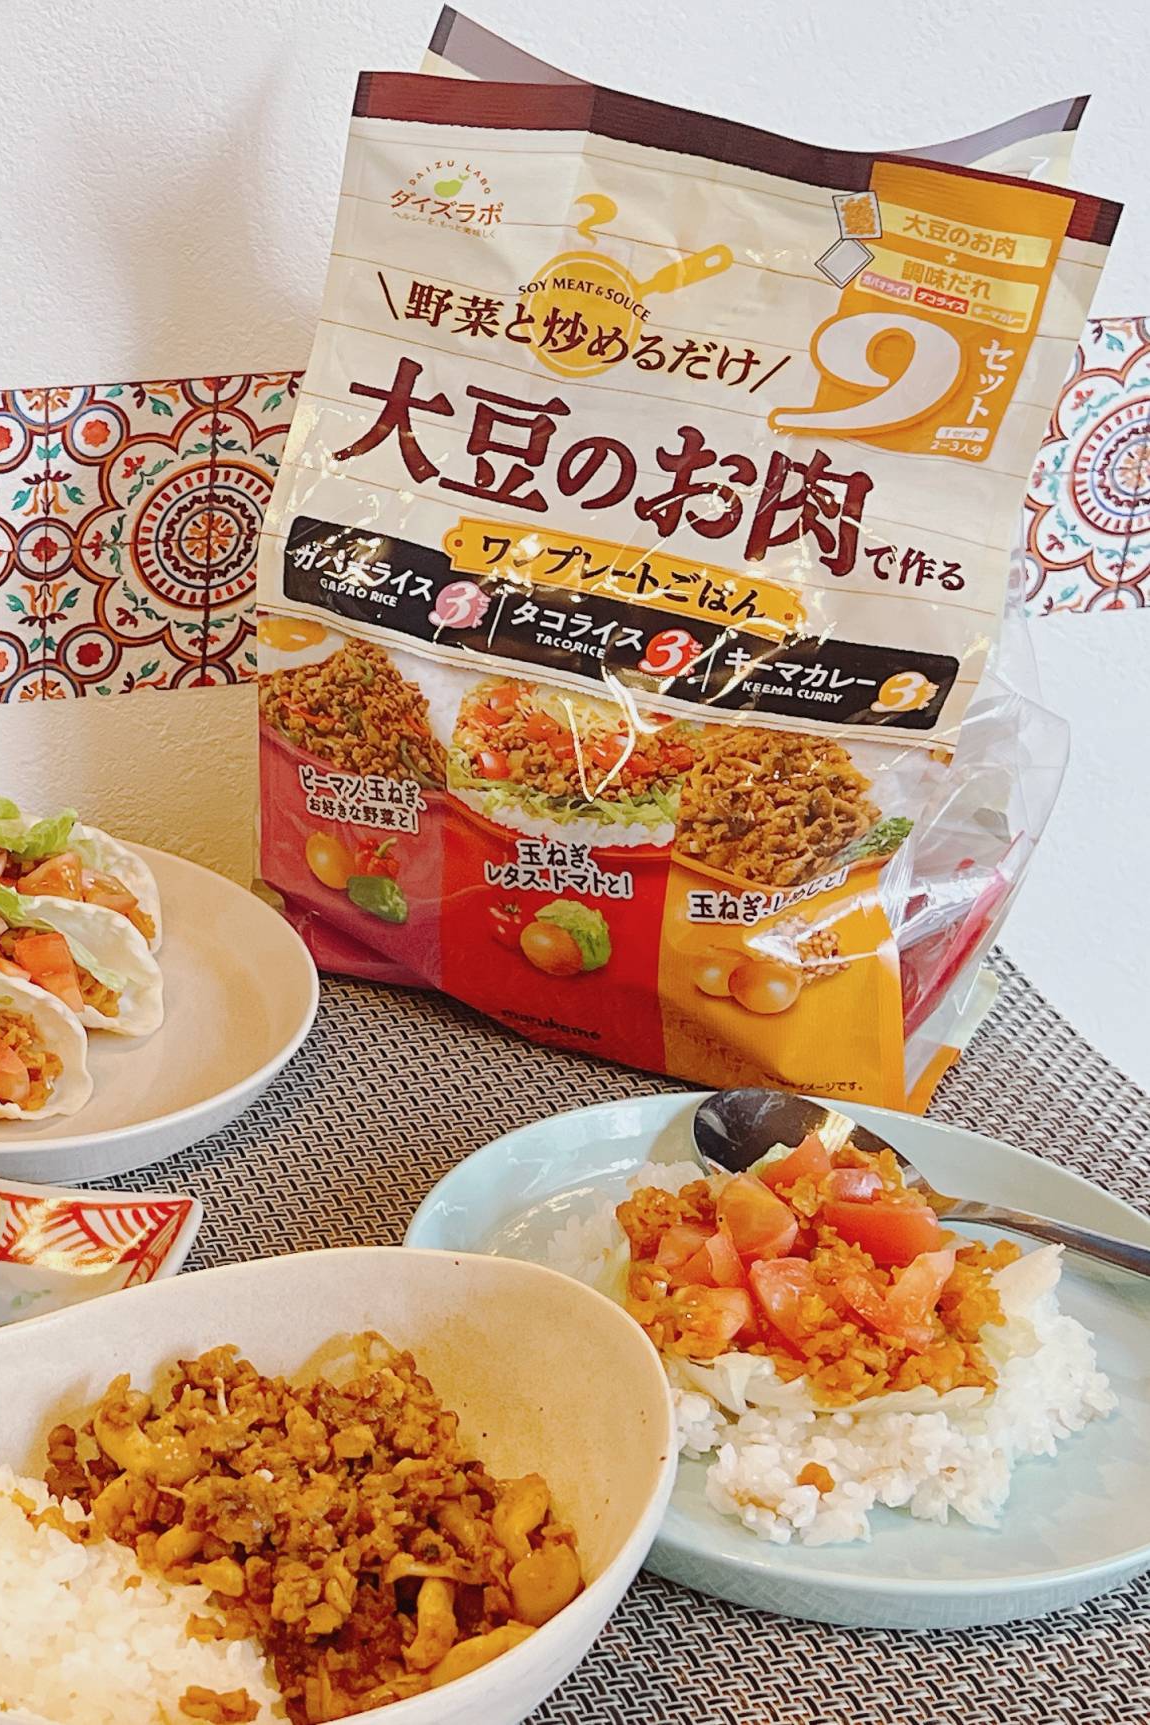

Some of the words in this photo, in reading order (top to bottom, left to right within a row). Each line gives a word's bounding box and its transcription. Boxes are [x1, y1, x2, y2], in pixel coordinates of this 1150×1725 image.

[408, 160, 455, 186] DAIZU
[465, 164, 491, 195] LABO
[390, 190, 504, 225] ダイズラボ
[902, 214, 1017, 260] 大豆のお肉
[518, 279, 548, 295] SOY
[552, 277, 594, 293] MEAT
[604, 288, 651, 322] SOUCE
[901, 259, 991, 300] 調味だれ
[404, 280, 761, 386] 野菜と炒めるだけ
[774, 312, 962, 430] 9
[965, 339, 1015, 425] セット
[319, 578, 368, 598] GAPAO
[369, 590, 399, 608] RICE
[510, 600, 646, 652] タコライス
[639, 629, 691, 673] 3
[725, 647, 877, 690] キーマカレー
[870, 671, 926, 713] 3
[741, 680, 793, 698] KEEMA
[796, 687, 844, 704] CURRY
